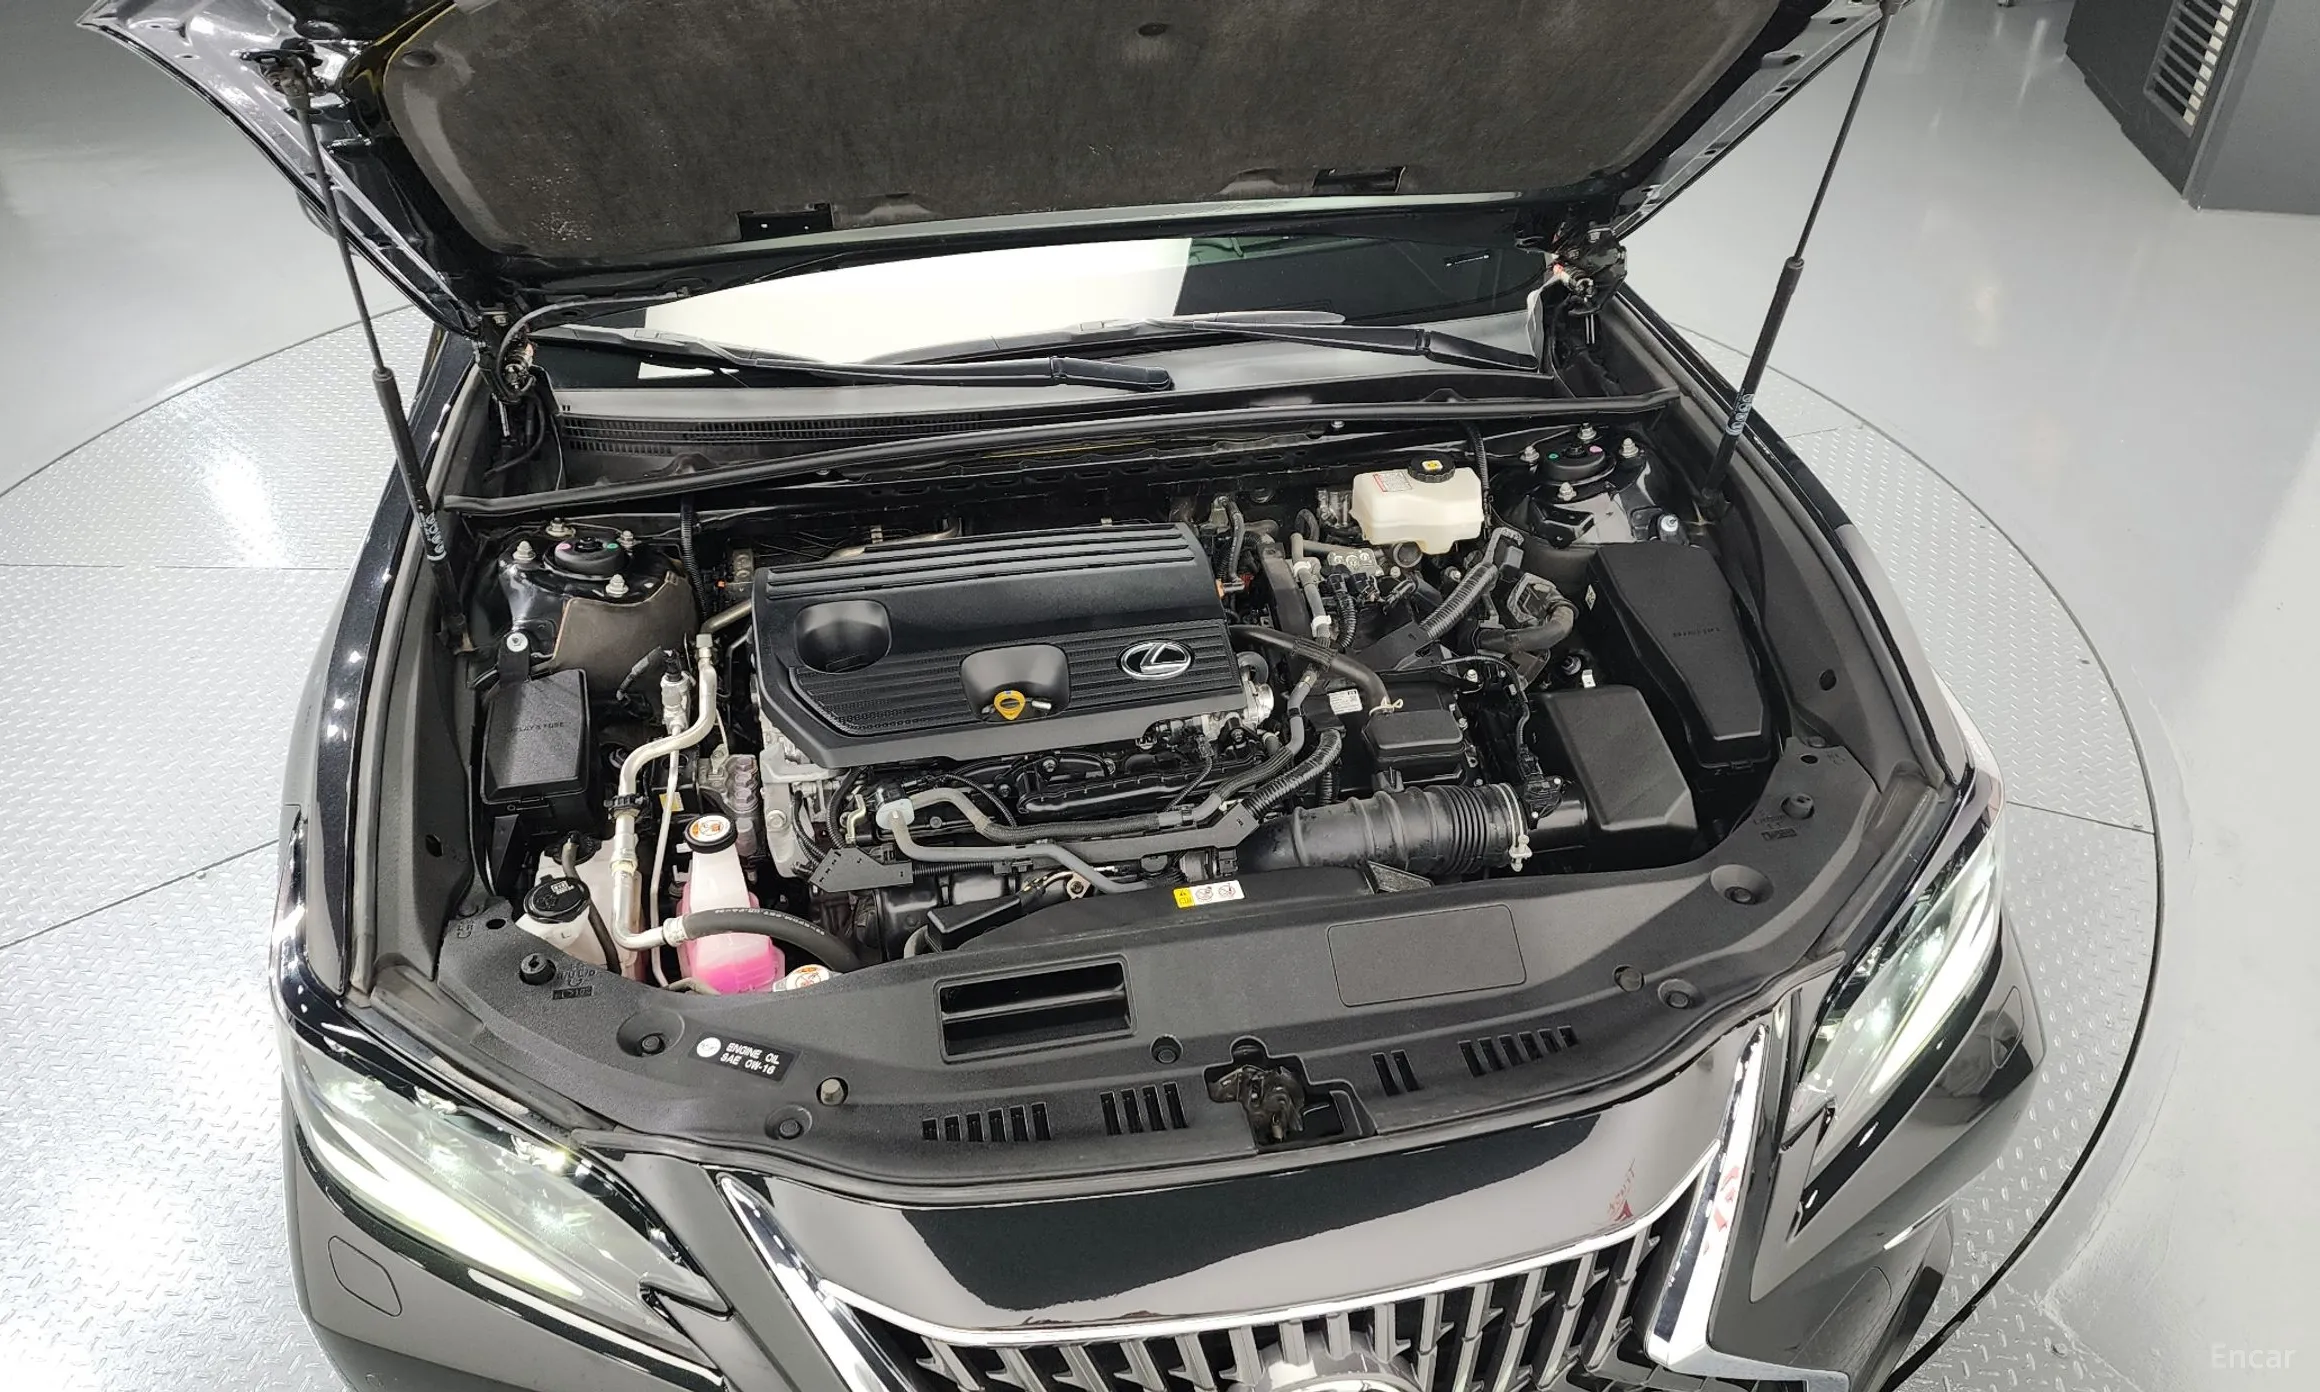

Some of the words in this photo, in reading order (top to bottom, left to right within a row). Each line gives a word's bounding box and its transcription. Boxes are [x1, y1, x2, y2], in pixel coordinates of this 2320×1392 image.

[720, 1053, 742, 1066] SAE
[726, 1043, 763, 1059] ENGINE
[765, 1053, 780, 1065] OIL
